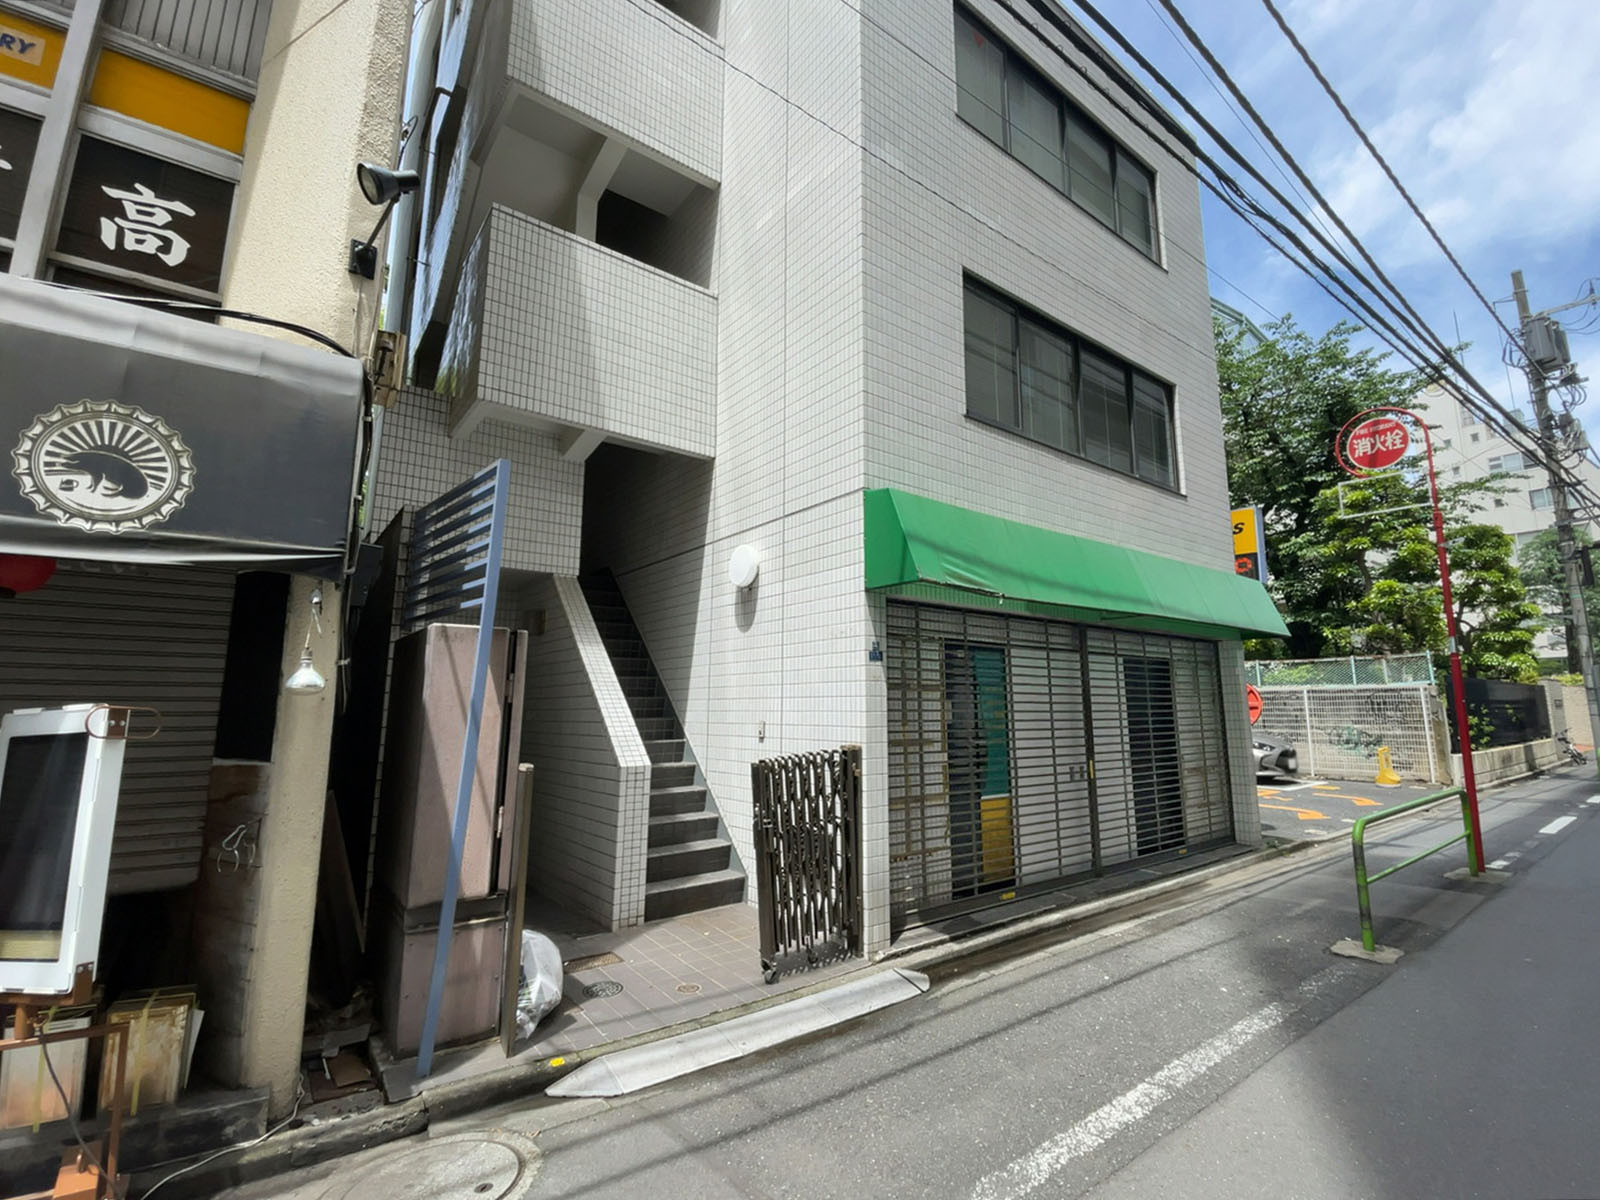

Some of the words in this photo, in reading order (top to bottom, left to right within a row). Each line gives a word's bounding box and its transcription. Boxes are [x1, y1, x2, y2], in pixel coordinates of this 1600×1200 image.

[100, 182, 196, 267] 高
[1353, 429, 1405, 458] 消火栓
